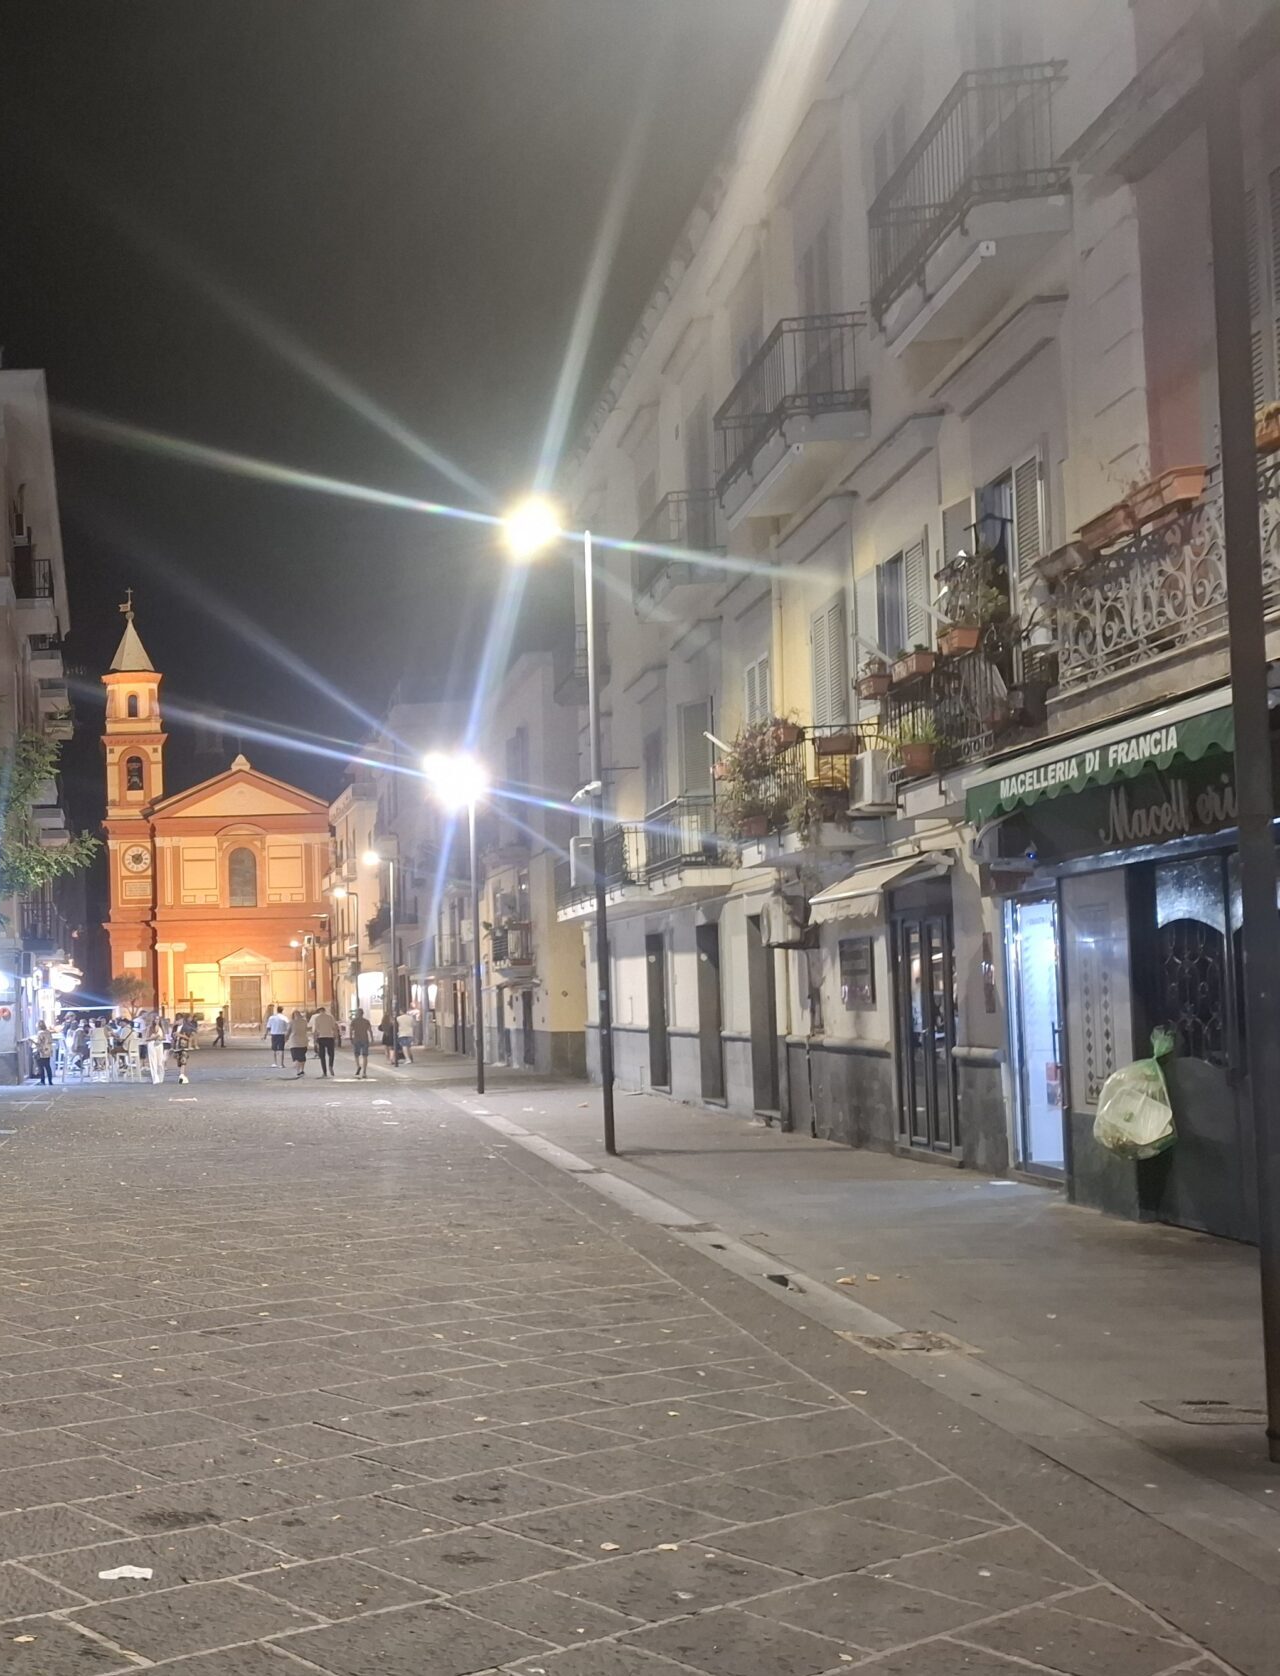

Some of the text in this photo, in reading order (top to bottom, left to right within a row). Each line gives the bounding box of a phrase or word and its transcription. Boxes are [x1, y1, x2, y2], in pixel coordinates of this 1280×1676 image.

[999, 725, 1178, 800] MACELLERIA DI FRANCIA
